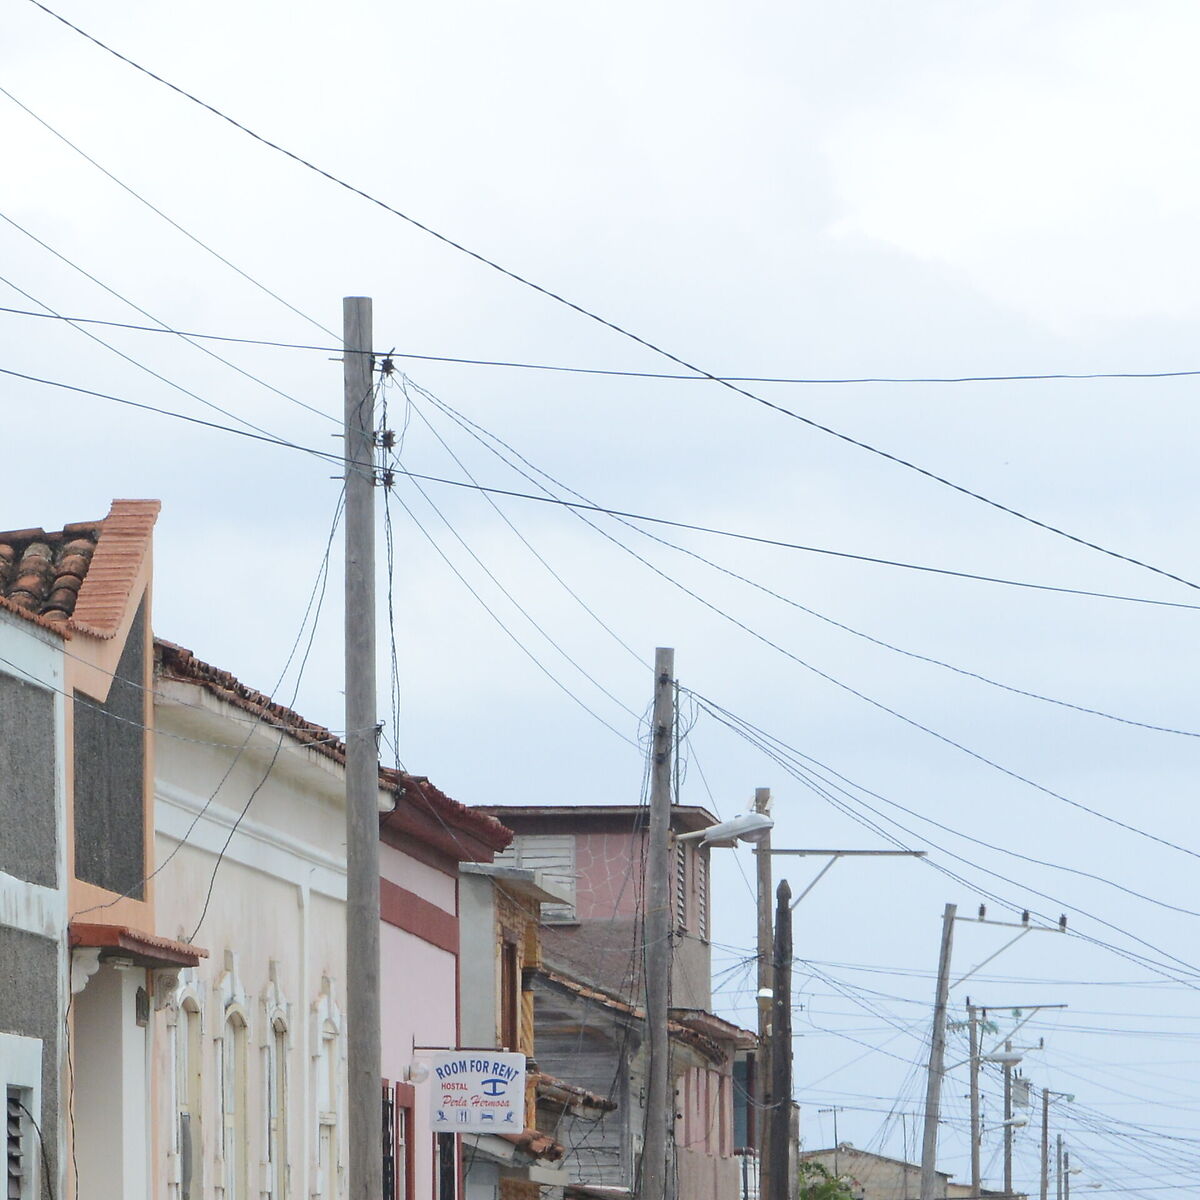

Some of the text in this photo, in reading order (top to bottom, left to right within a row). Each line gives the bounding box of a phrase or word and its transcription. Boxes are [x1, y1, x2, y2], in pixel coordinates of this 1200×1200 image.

[436, 1059, 519, 1081] ROOM FOR RENT
[441, 1083, 468, 1091] HOSTAL
[442, 1095, 510, 1107] Perla Hermosa
